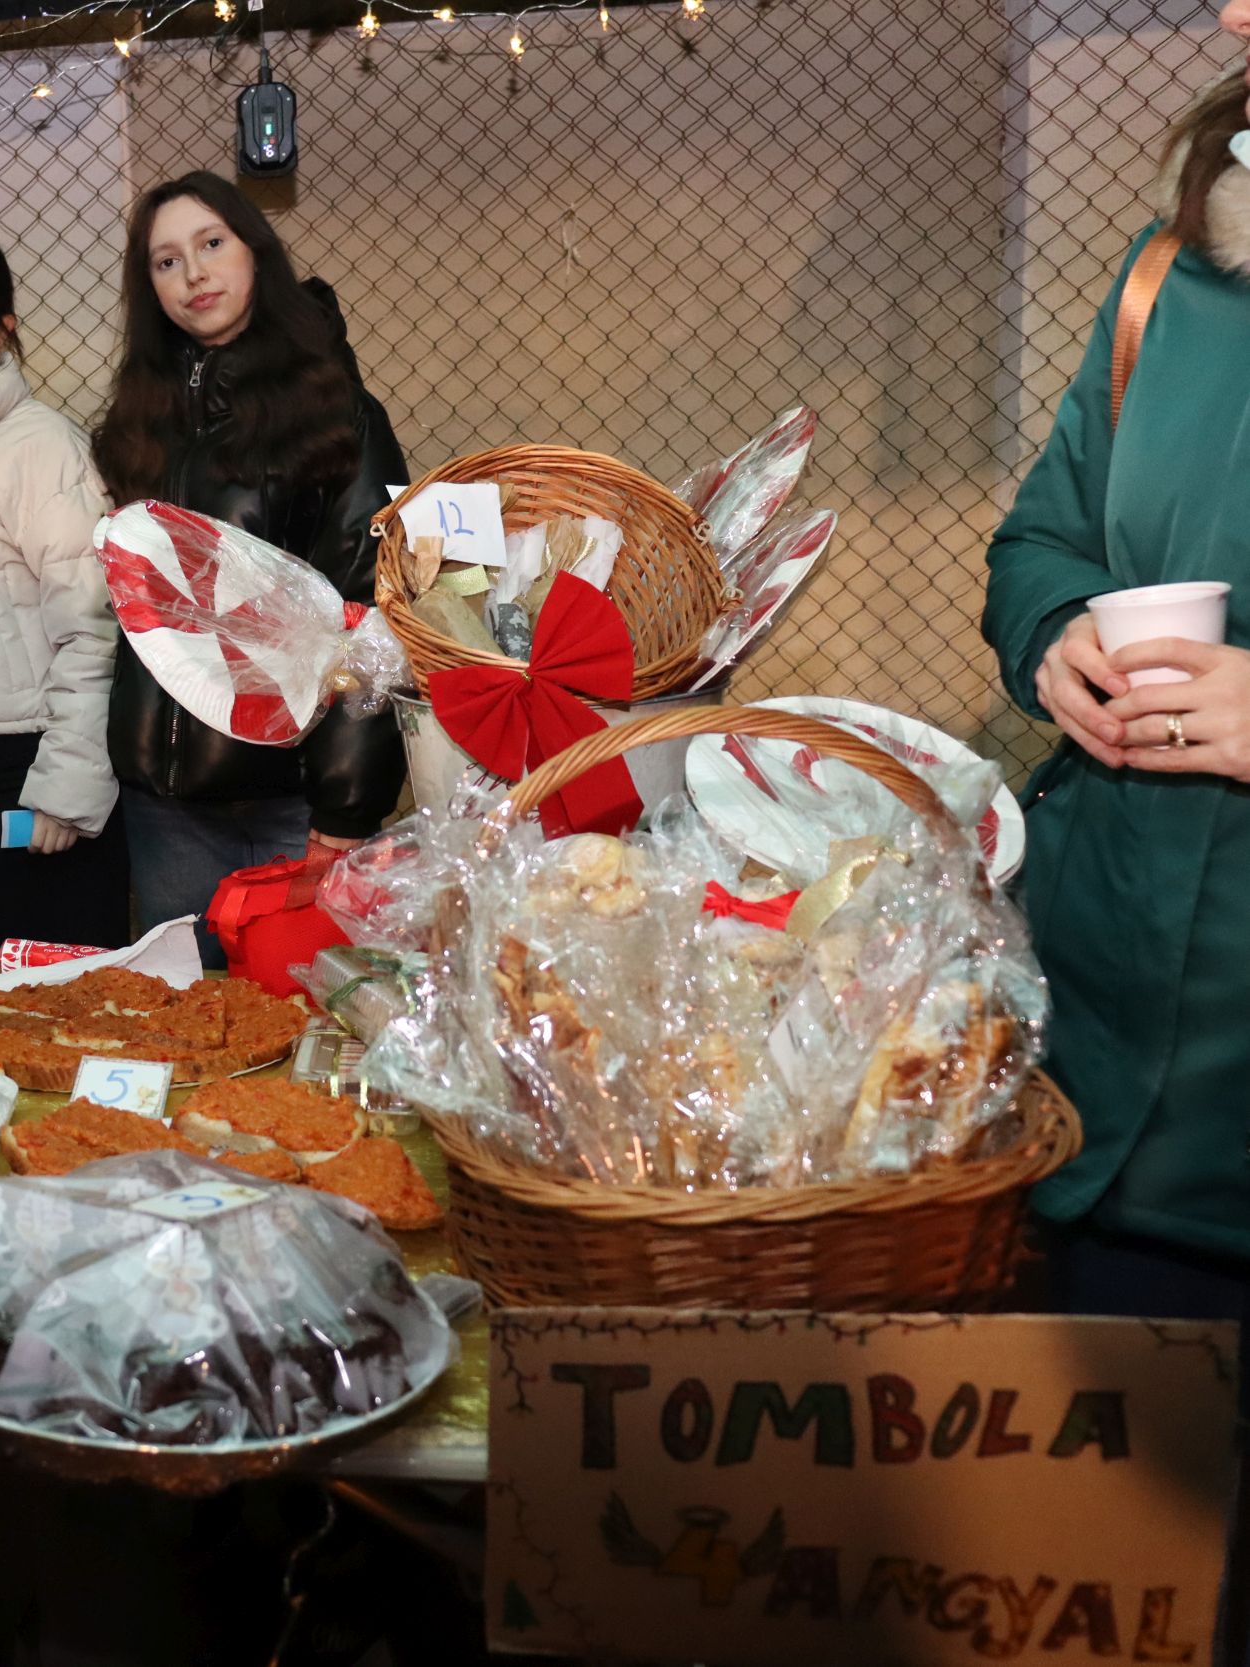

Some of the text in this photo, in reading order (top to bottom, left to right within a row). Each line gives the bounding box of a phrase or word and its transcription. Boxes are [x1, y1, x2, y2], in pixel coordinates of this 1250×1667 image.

[437, 500, 475, 538] 12
[90, 1068, 134, 1105] 5
[551, 1362, 1131, 1470] TOMBOLA
[762, 1546, 1198, 1664] ANGYAL
